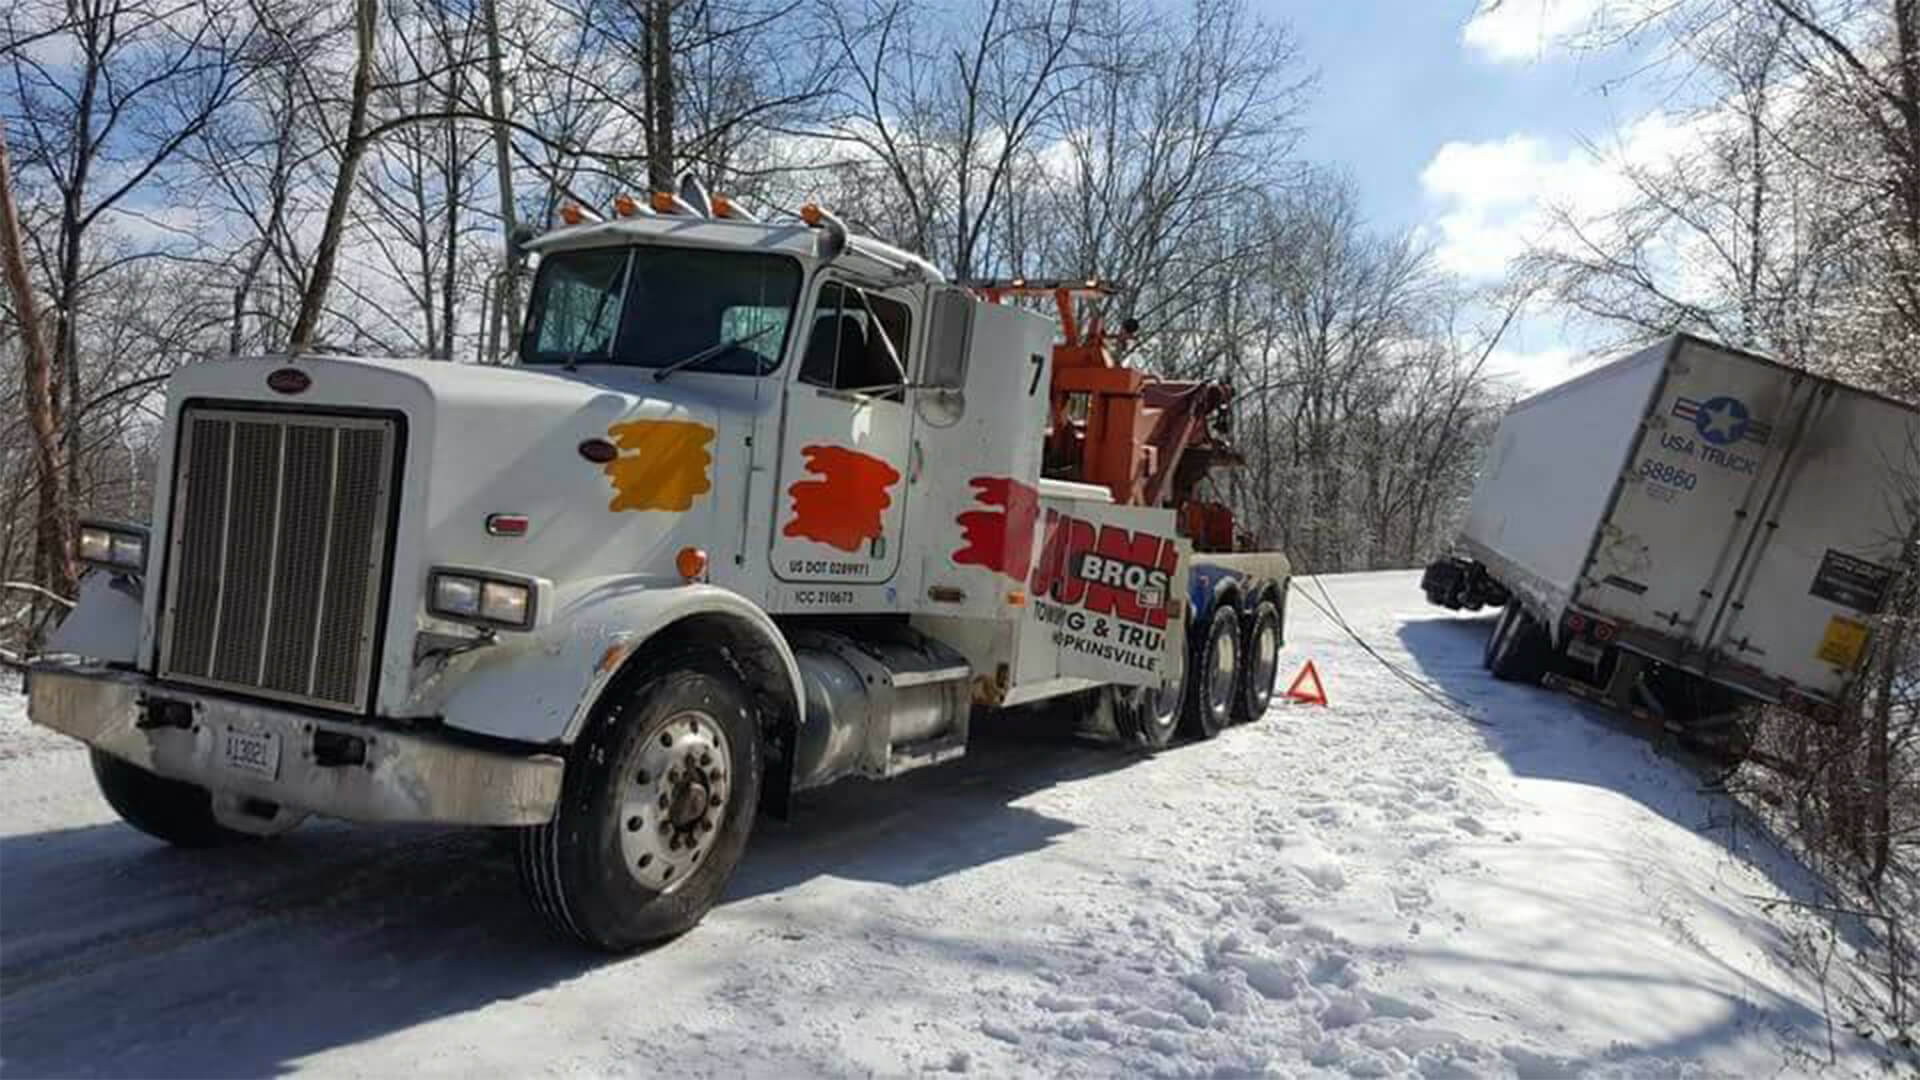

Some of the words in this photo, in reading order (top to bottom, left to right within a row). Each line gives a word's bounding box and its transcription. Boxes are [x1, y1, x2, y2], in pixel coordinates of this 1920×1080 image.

[1029, 353, 1044, 397] 7
[1661, 432, 1695, 454] USA
[1701, 444, 1759, 475] TRUCK
[1640, 459, 1697, 491] 58860
[789, 560, 803, 573] US
[806, 561, 828, 574] DOT
[1080, 554, 1169, 595] BROS
[795, 591, 815, 604] ICC
[1092, 619, 1110, 639] &
